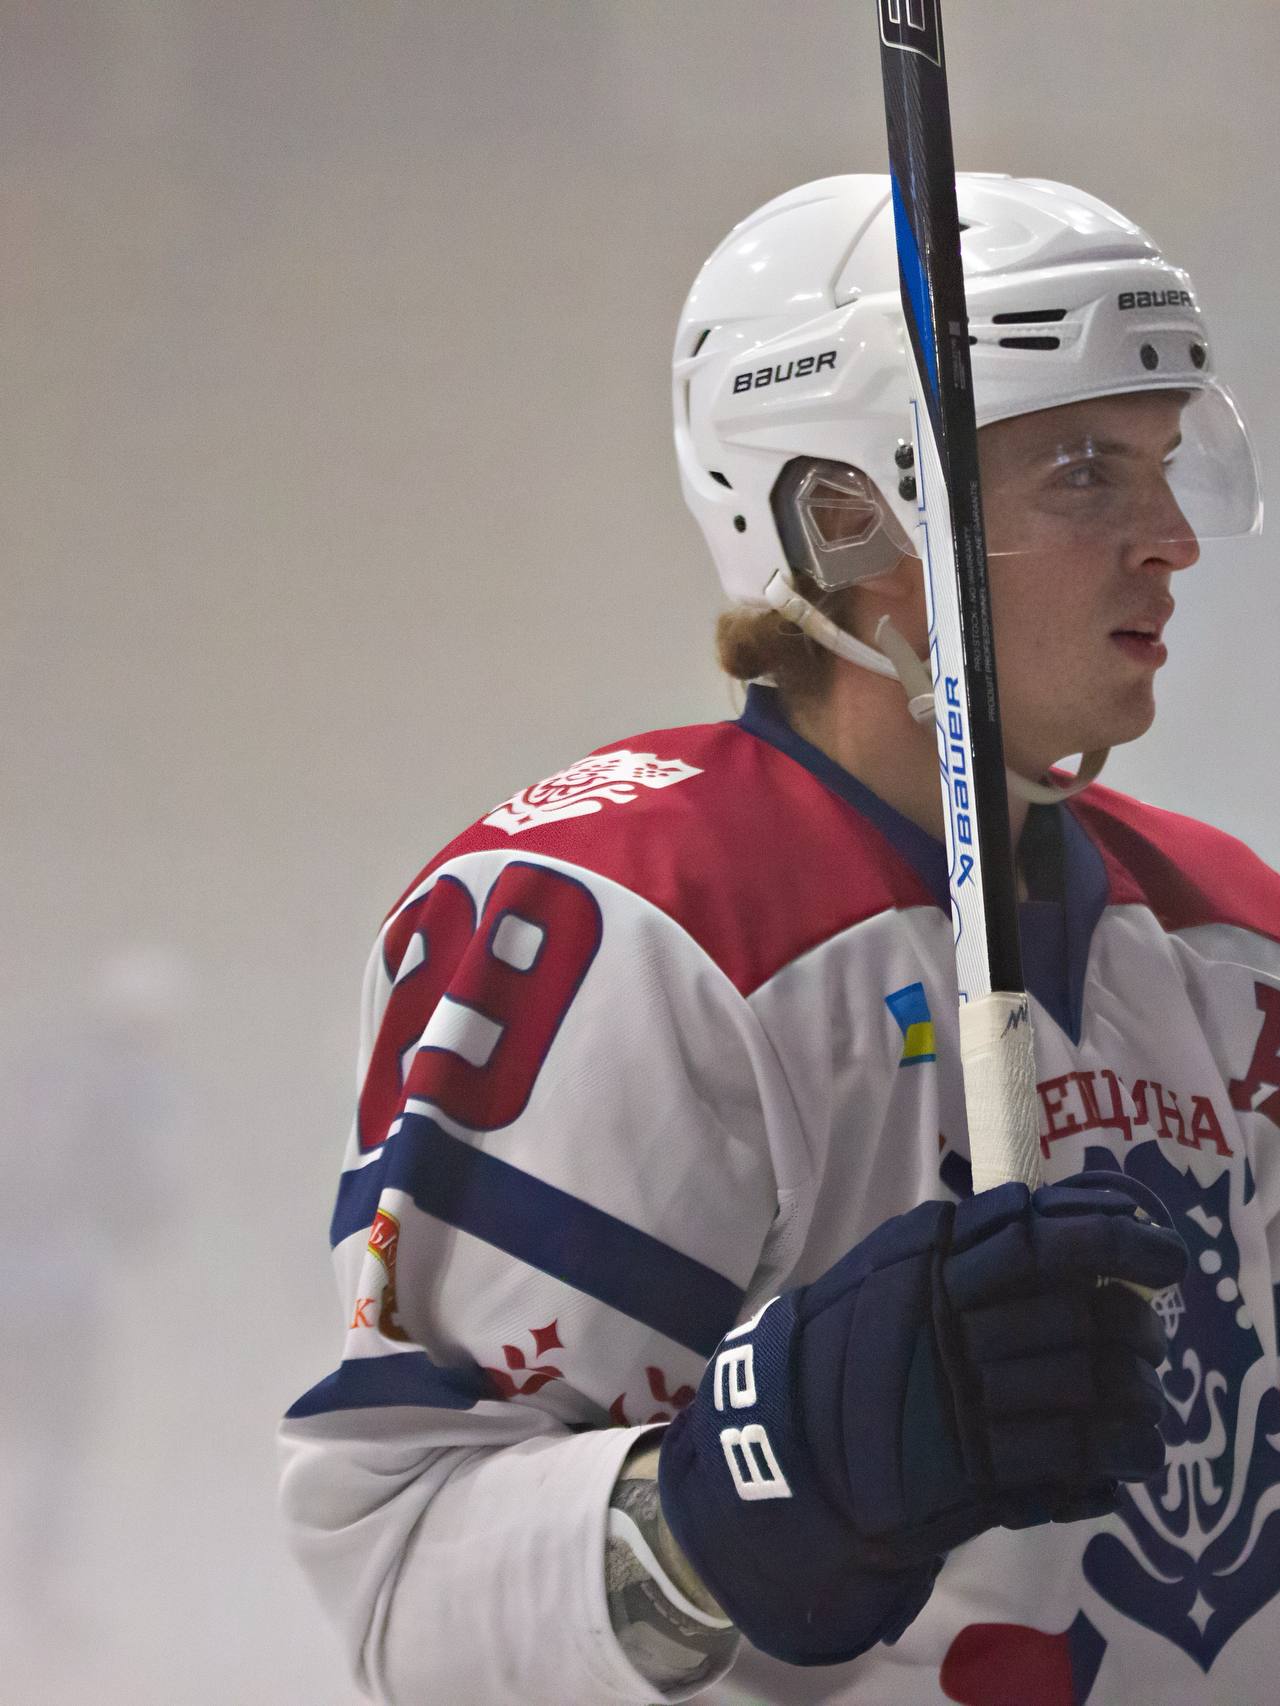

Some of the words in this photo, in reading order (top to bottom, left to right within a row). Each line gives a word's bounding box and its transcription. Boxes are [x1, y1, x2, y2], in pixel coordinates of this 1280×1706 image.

[1118, 290, 1194, 311] BAUER
[733, 350, 837, 394] BAUER
[945, 676, 972, 846] BAUER
